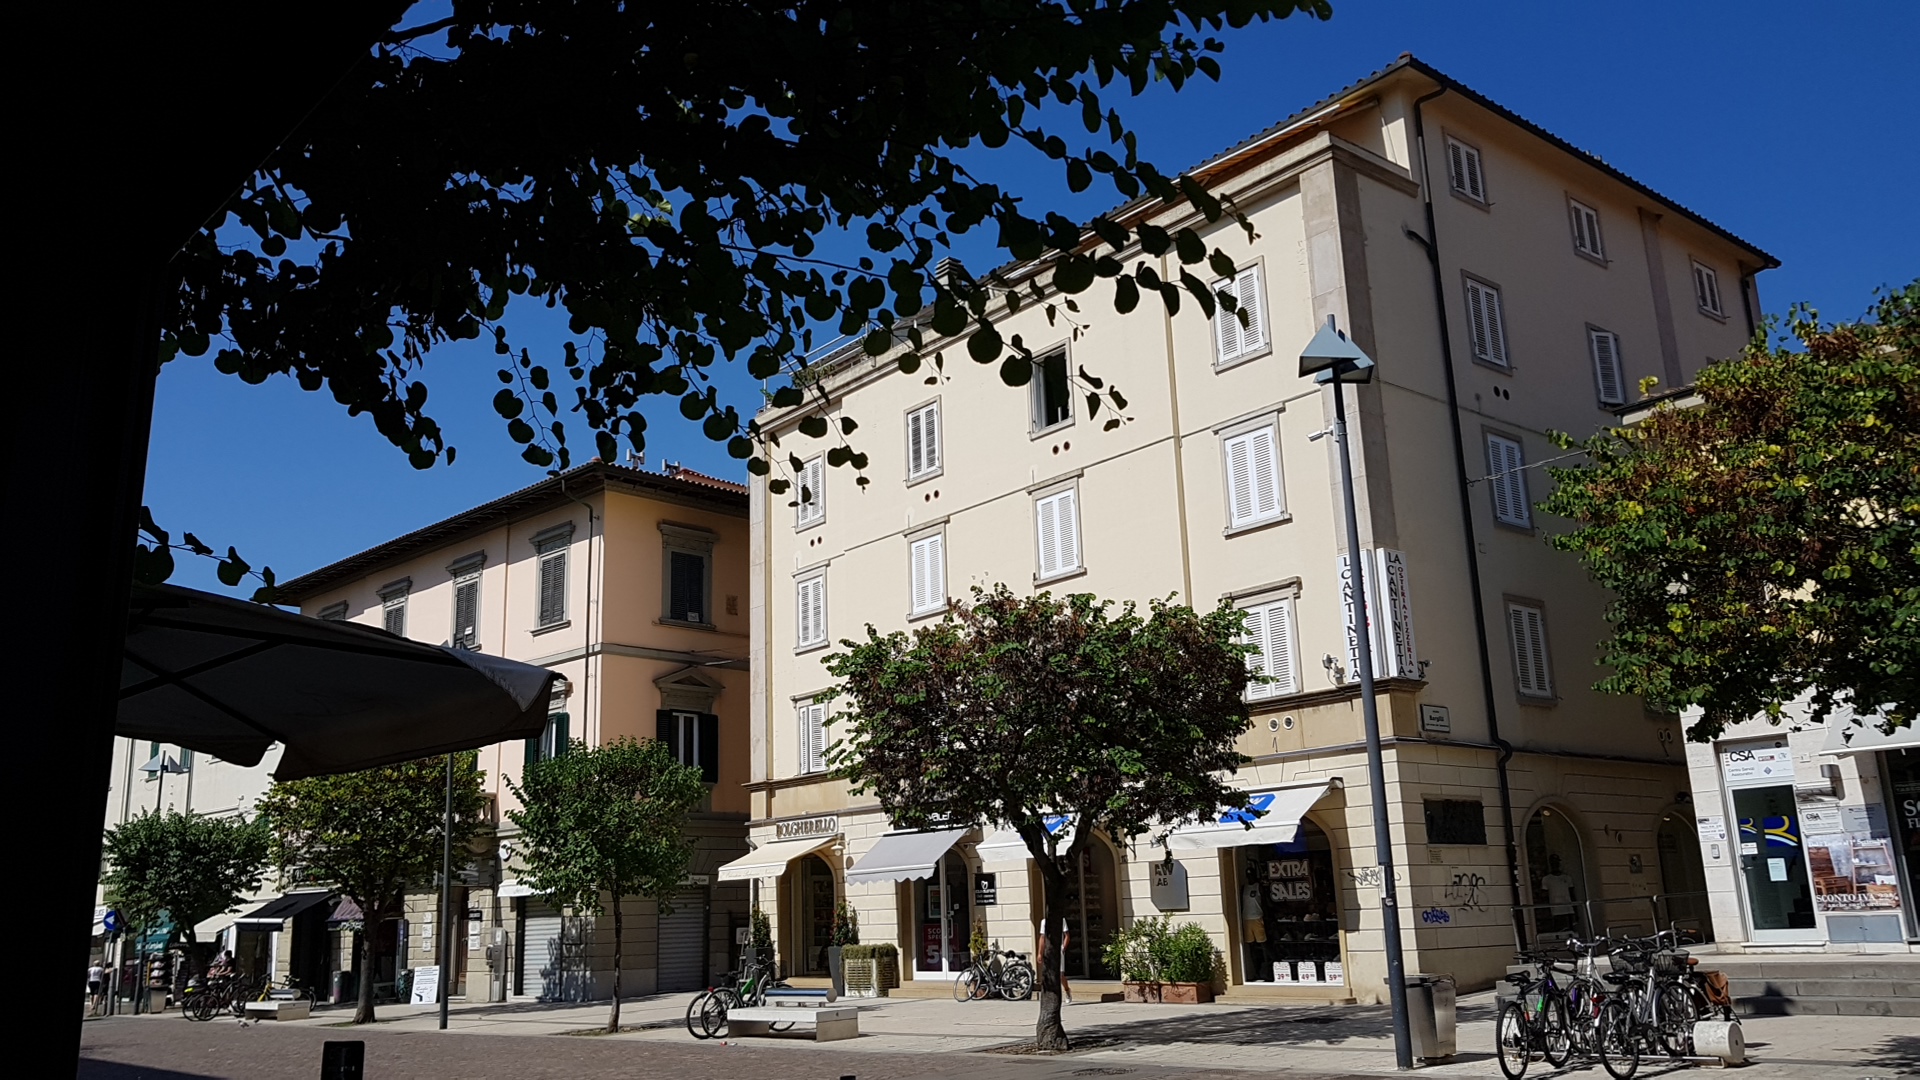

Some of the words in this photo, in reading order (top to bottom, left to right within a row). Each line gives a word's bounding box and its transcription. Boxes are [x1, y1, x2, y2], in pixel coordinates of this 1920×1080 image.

[1387, 551, 1402, 565] LA
[1341, 568, 1361, 680] CANTINETTA
[1387, 565, 1407, 677] CANTINETTA
[1403, 615, 1414, 667] PIZZERIA
[1729, 749, 1756, 762] CSA
[1805, 812, 1821, 821] CSA
[776, 817, 836, 839] BOLGHERELLO
[1269, 861, 1310, 878] EXTRA
[1270, 882, 1311, 901] SALES
[1816, 893, 1857, 903] SCONTO
[1858, 893, 1875, 902] IVA
